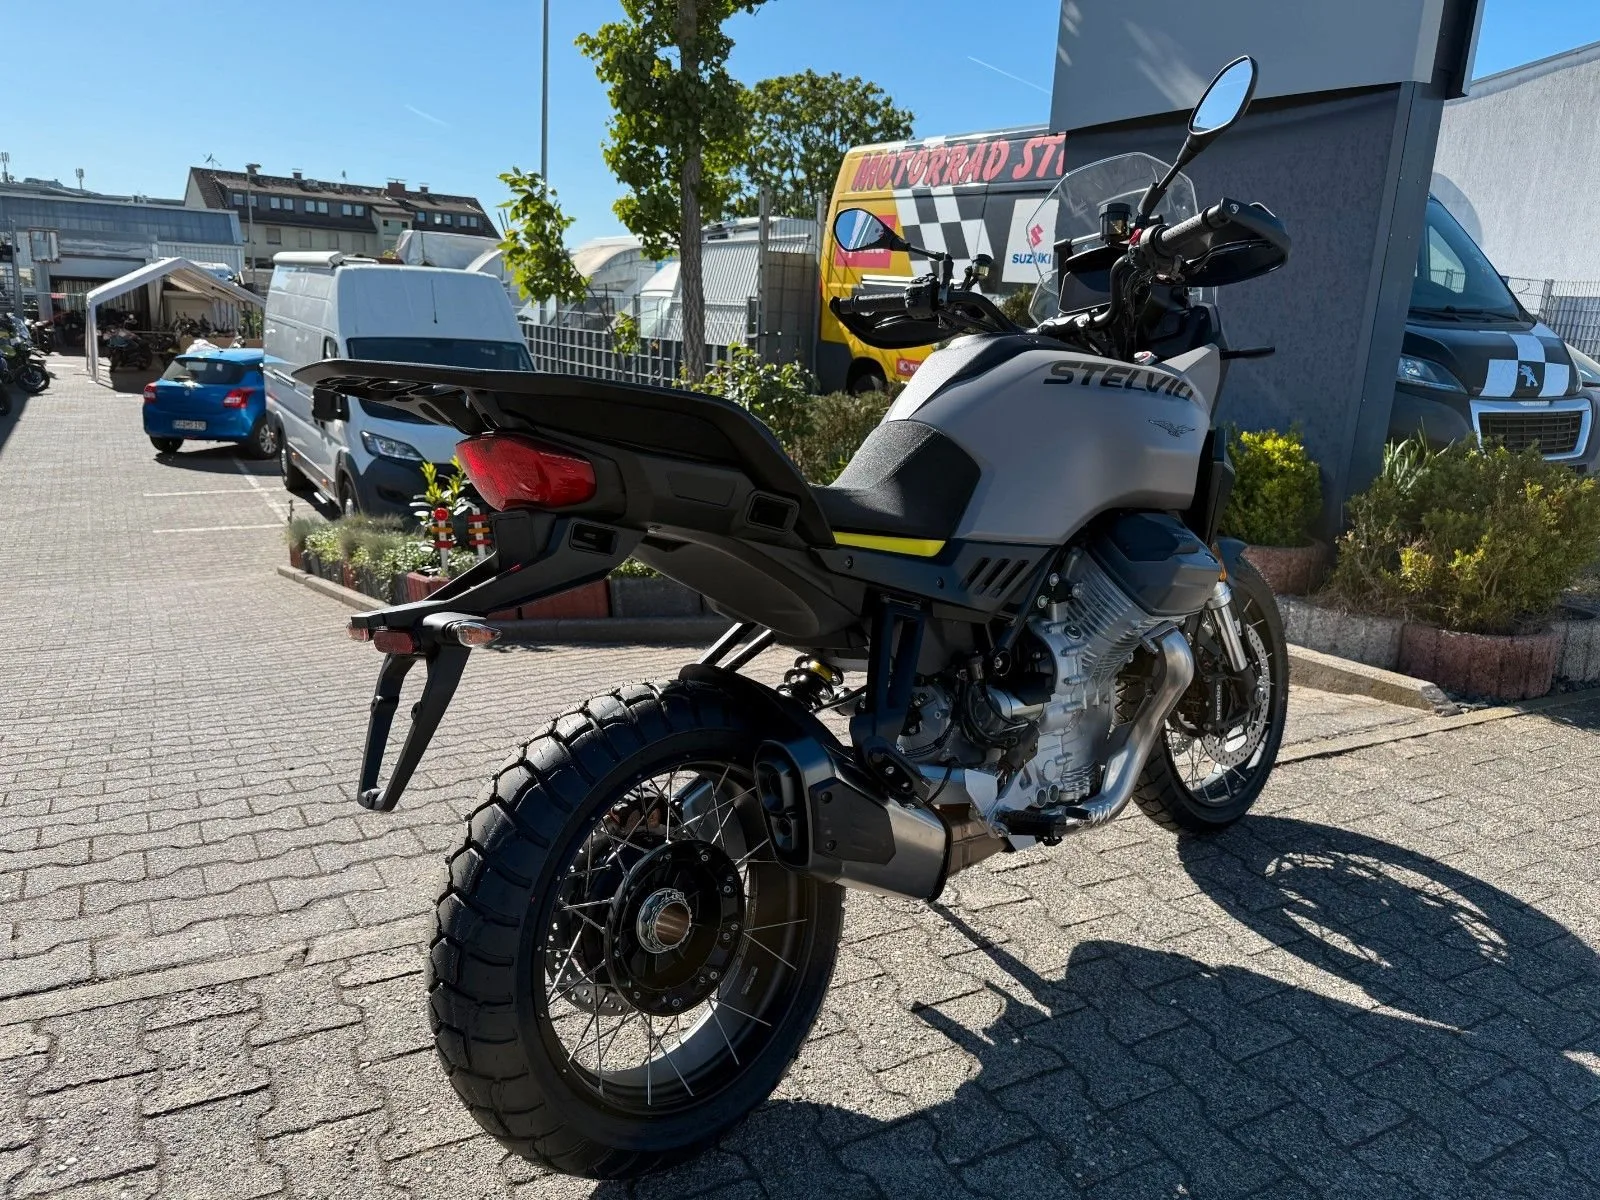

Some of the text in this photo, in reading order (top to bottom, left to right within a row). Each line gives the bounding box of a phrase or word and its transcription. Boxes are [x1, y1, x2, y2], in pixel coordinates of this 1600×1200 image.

[851, 140, 1010, 191] MOTORRAD
[1012, 252, 1051, 264] SUZUKI
[1043, 360, 1194, 401] STELVIO
